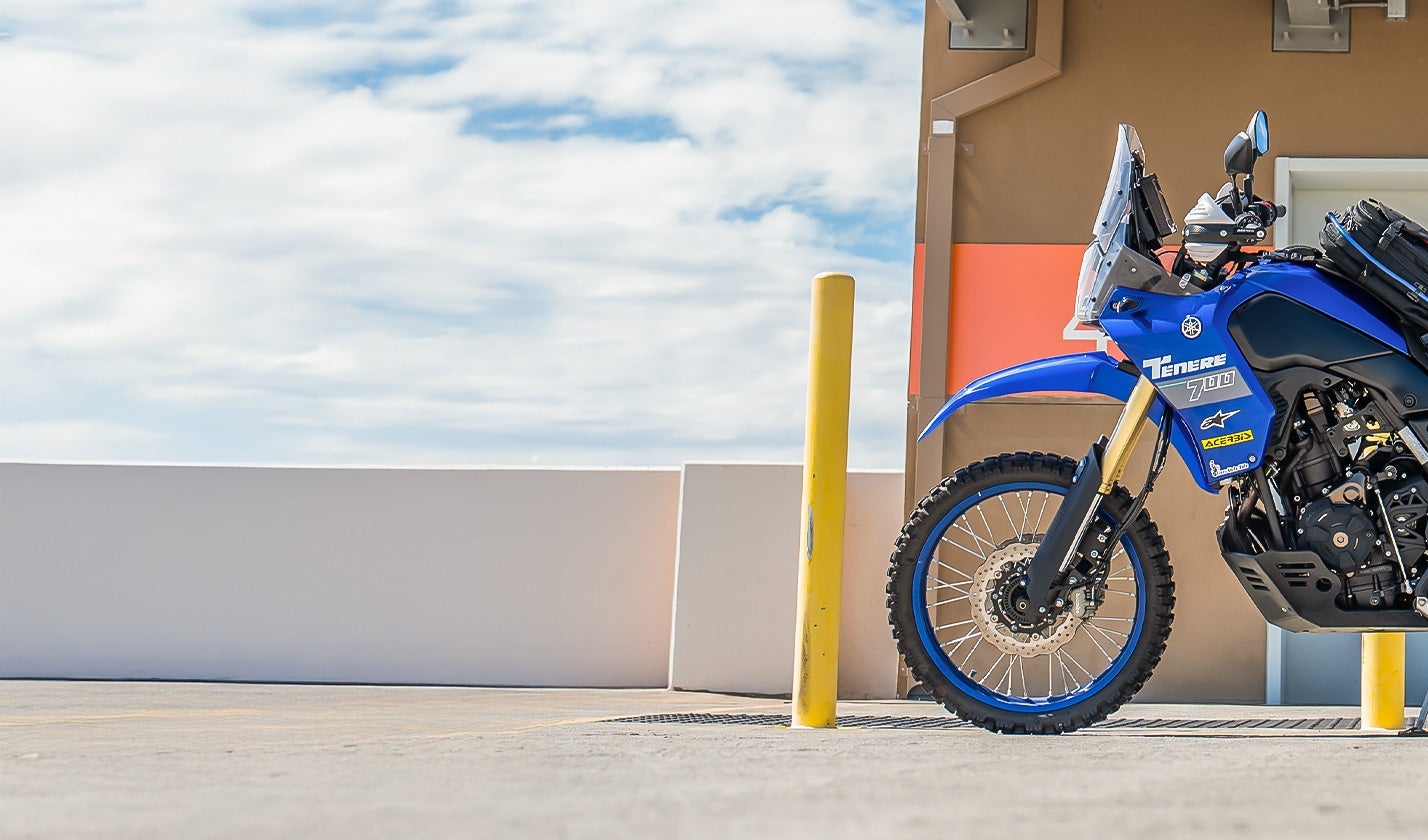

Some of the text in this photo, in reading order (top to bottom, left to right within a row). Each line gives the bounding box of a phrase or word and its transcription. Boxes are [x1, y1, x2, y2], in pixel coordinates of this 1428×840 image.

[1143, 353, 1226, 379] TENERE
[1186, 370, 1236, 402] 700
[1204, 432, 1252, 448] ACERBIS
